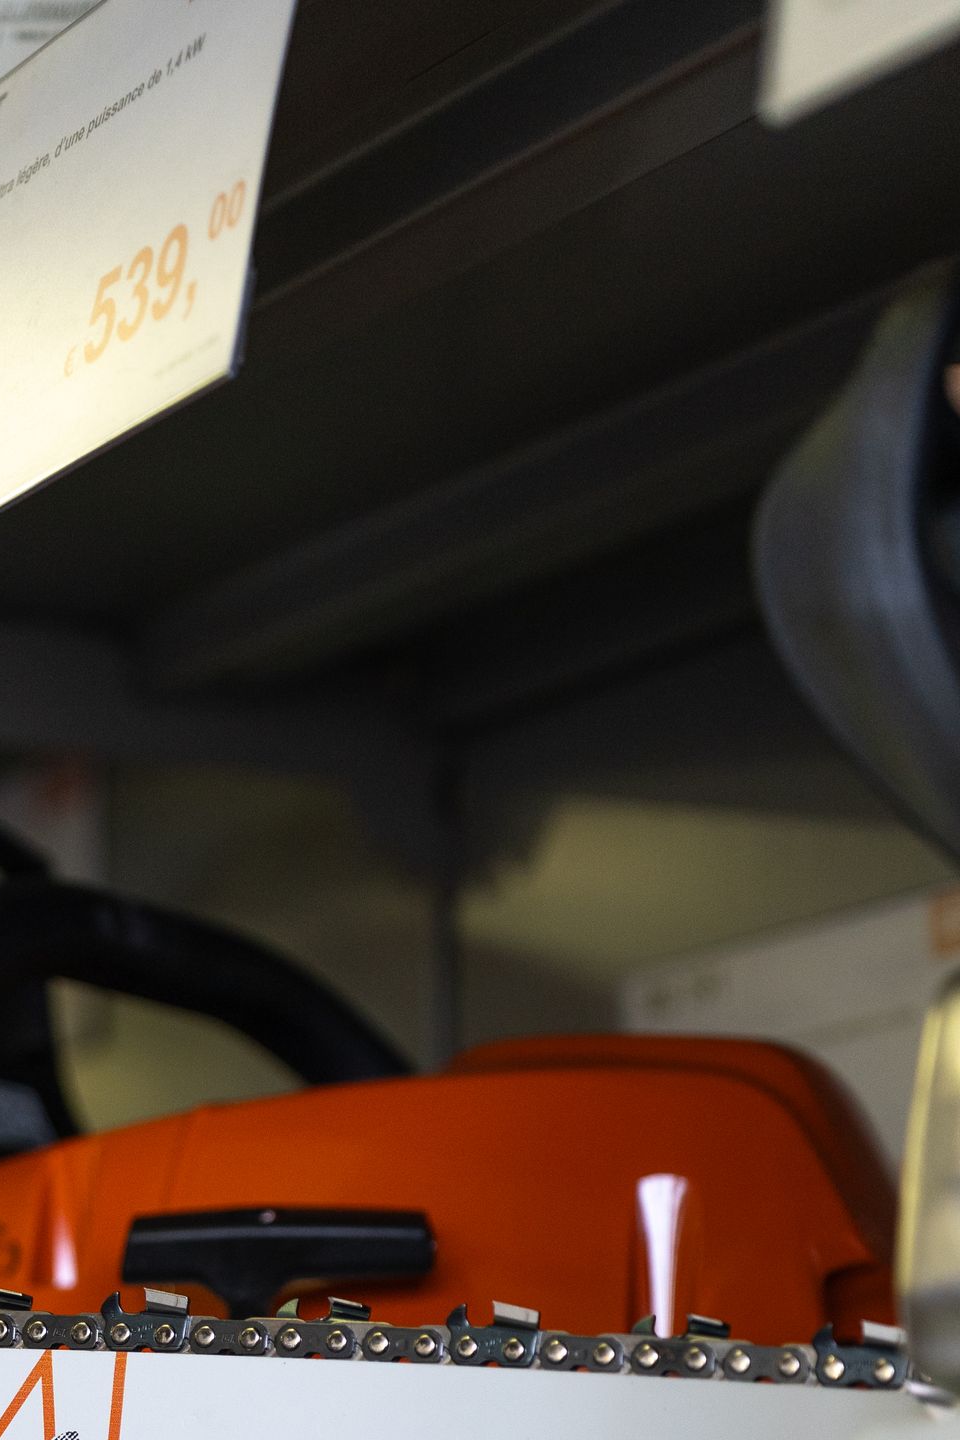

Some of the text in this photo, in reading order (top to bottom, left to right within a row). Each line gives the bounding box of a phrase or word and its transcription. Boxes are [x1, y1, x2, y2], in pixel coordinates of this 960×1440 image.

[54, 126, 86, 159] d'une
[86, 82, 146, 140] puissance
[147, 68, 163, 90] de
[166, 49, 184, 77] 1,4
[185, 32, 207, 62] kW
[207, 177, 247, 241] 00
